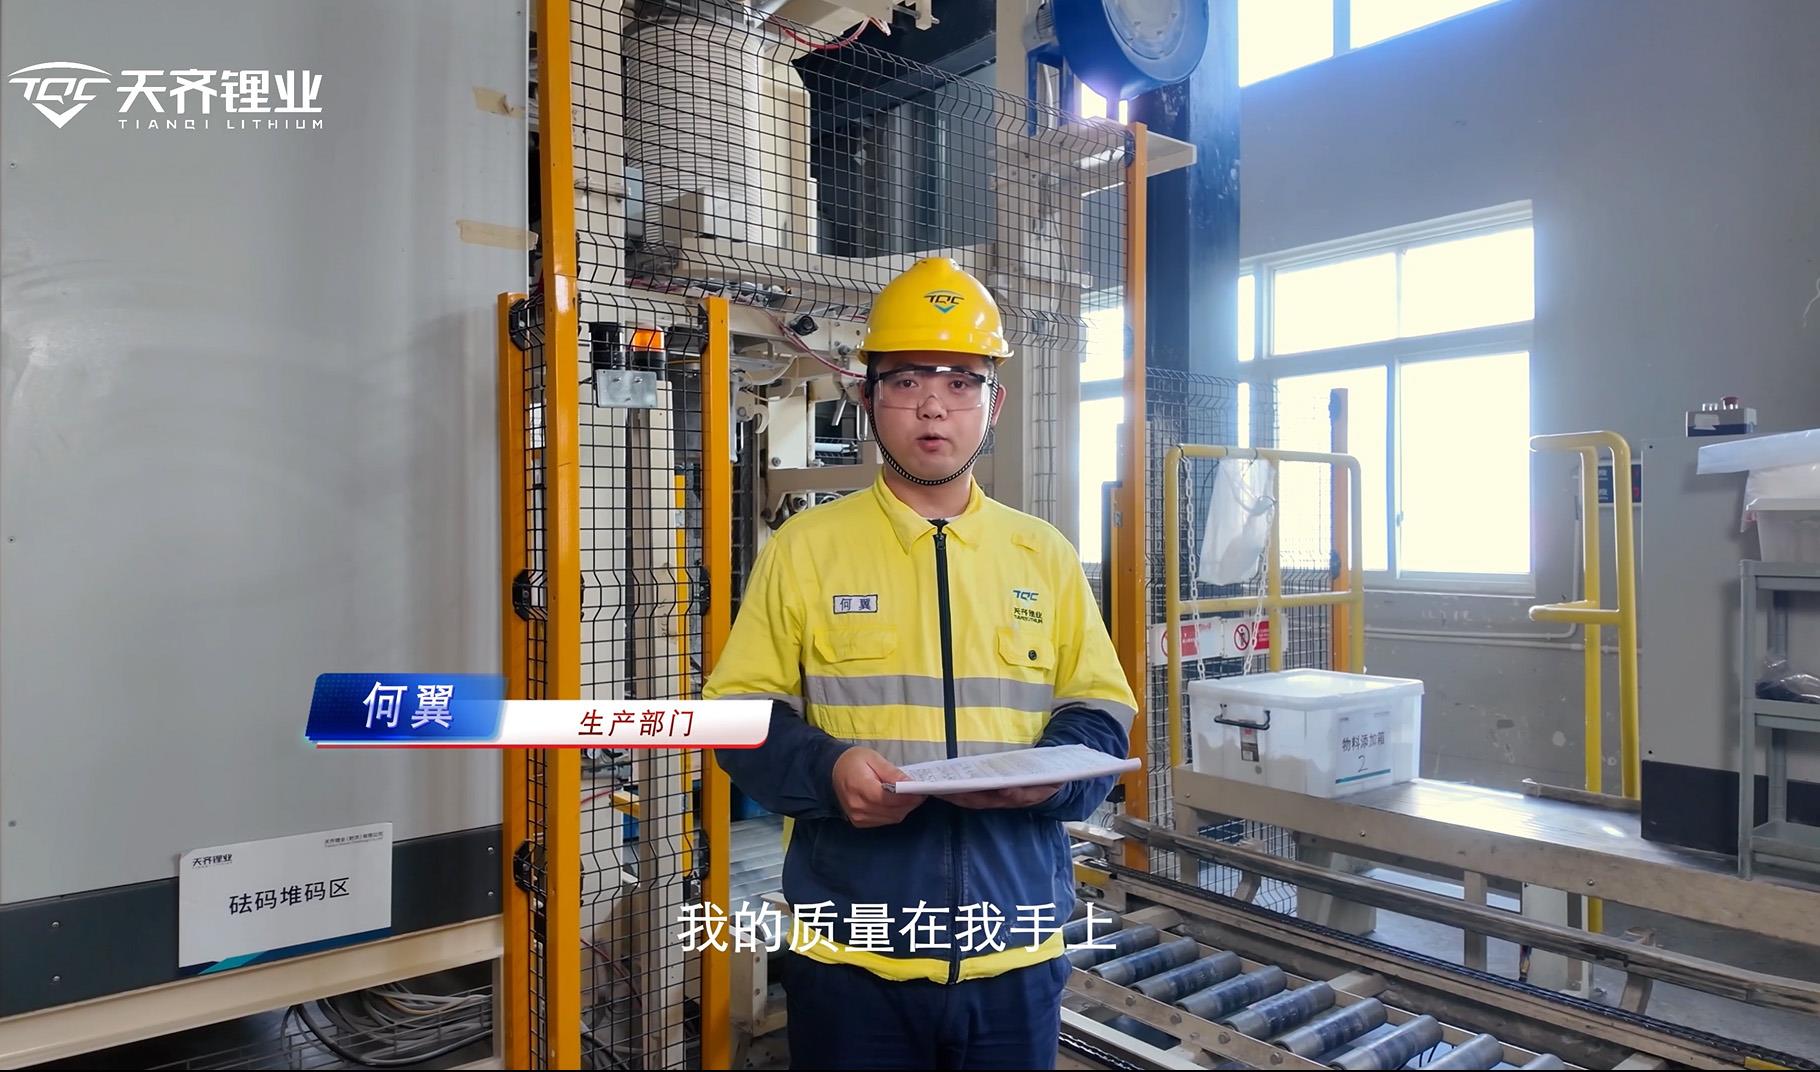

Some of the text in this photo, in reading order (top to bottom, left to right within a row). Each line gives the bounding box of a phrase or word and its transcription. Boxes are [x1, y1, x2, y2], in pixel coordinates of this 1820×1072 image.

[1342, 731, 1385, 752] 物料添加箱
[1358, 754, 1369, 773] 2
[228, 876, 350, 915] 砝码堆码区
